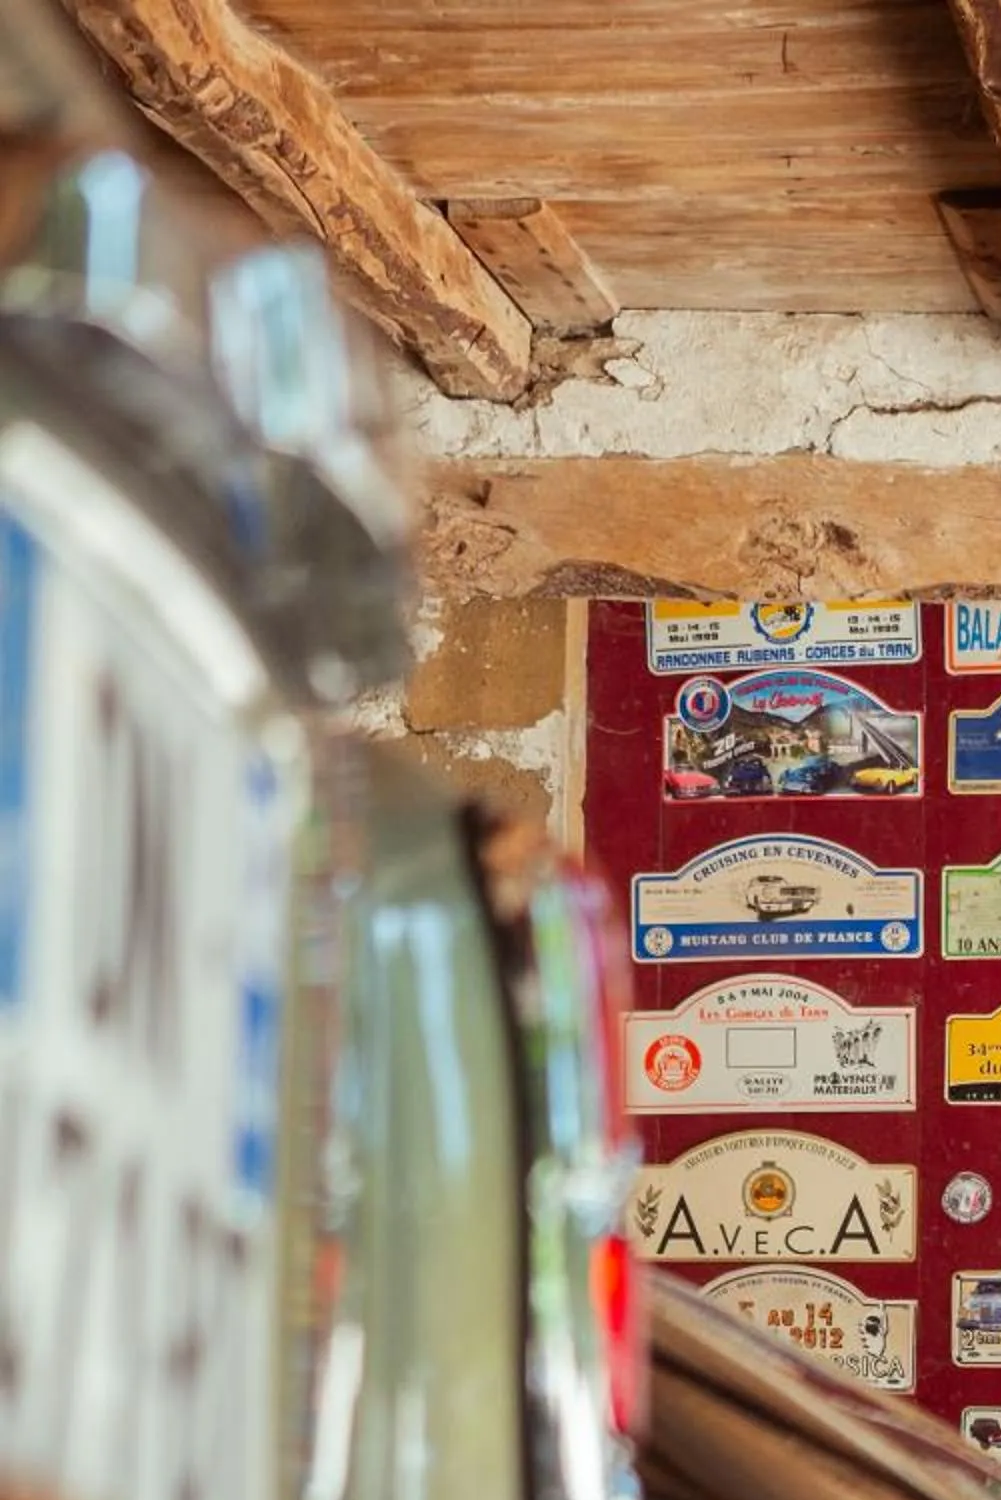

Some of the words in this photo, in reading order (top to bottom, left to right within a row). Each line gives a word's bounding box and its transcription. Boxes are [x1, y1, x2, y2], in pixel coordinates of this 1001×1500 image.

[737, 648, 796, 664] AUBENAS
[805, 644, 855, 660] GORGES
[858, 645, 875, 657] du
[878, 642, 912, 657] TARN
[692, 848, 758, 883] CRUISING
[763, 845, 782, 858] EN
[787, 846, 860, 879] CEVENNES
[680, 934, 748, 948] MUSTANG
[752, 932, 789, 945] CLUB
[794, 932, 813, 944] DE
[818, 931, 874, 944] FRANCE
[957, 936, 973, 951] 10
[751, 987, 773, 997] MAI
